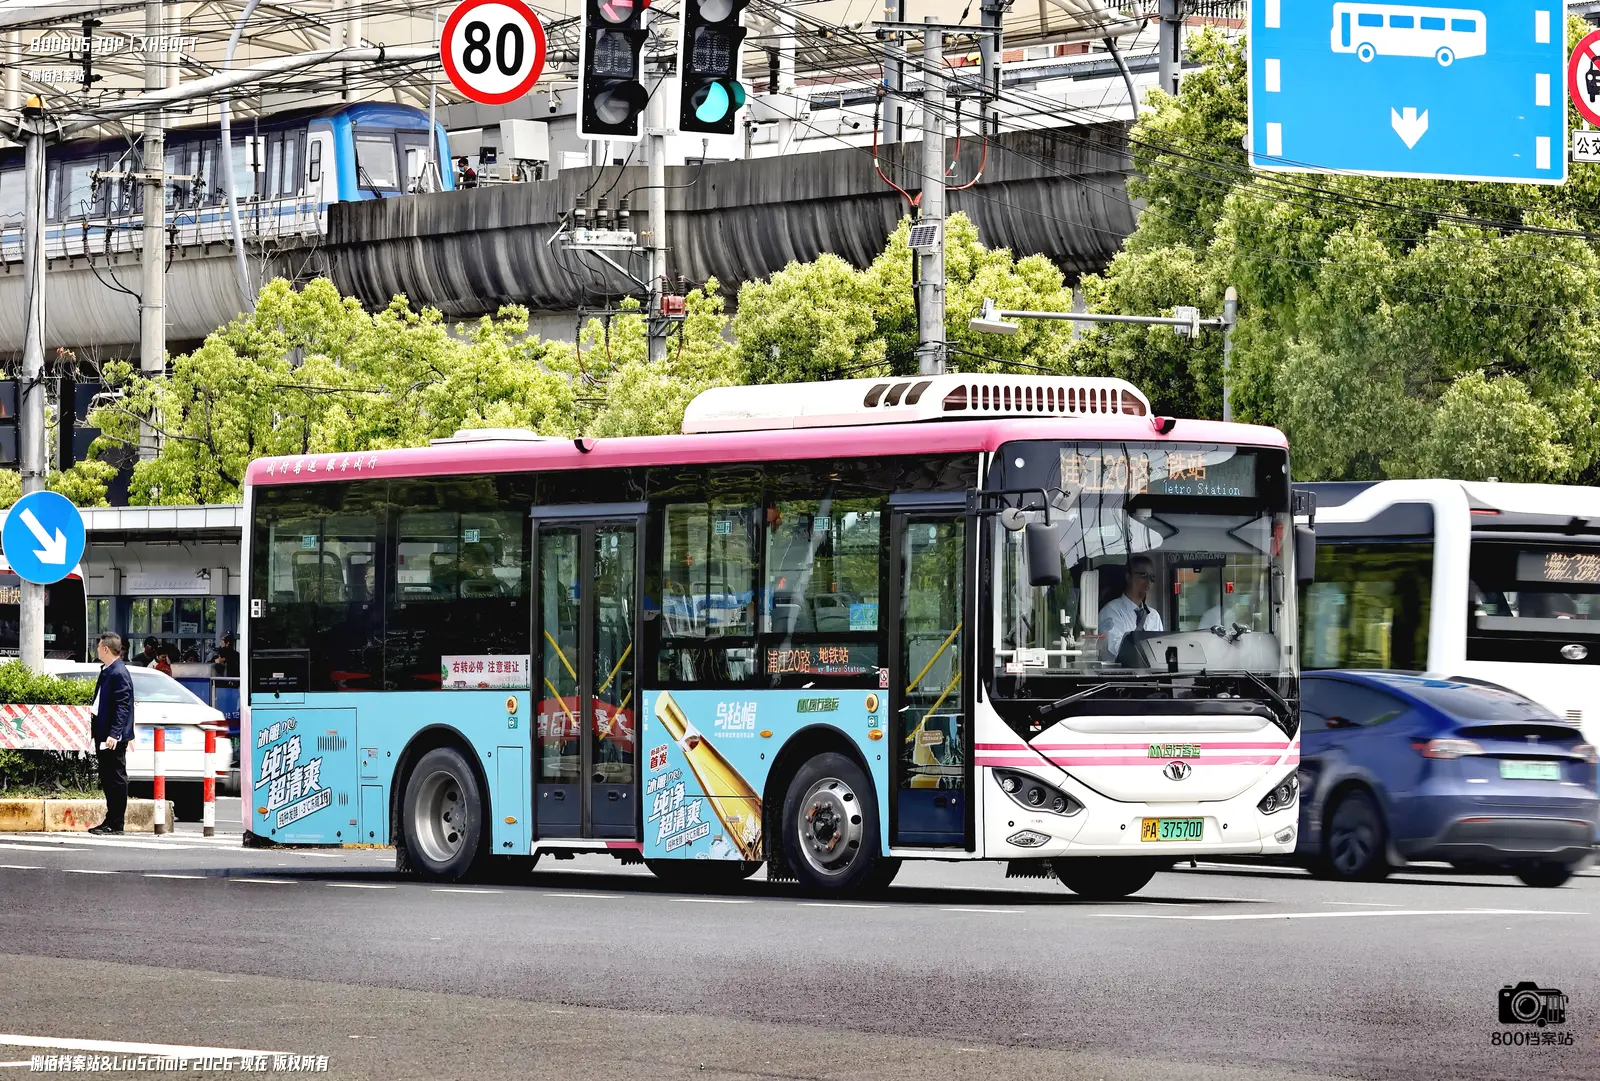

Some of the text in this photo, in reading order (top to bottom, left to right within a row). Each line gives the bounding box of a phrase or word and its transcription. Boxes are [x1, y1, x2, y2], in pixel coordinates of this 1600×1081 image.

[462, 21, 524, 76] 80
[1197, 483, 1241, 495] Station
[452, 660, 520, 673] 右转必停 注意避让
[767, 646, 849, 674] 浦江20路 地铁站
[843, 664, 867, 673] Station
[714, 701, 757, 730] 乌毡帽
[254, 735, 301, 791] 纯净
[264, 757, 323, 821] 超清爽
[648, 782, 685, 823] 纯净
[656, 798, 703, 846] 超清爽
[1161, 821, 1203, 838] 37570D
